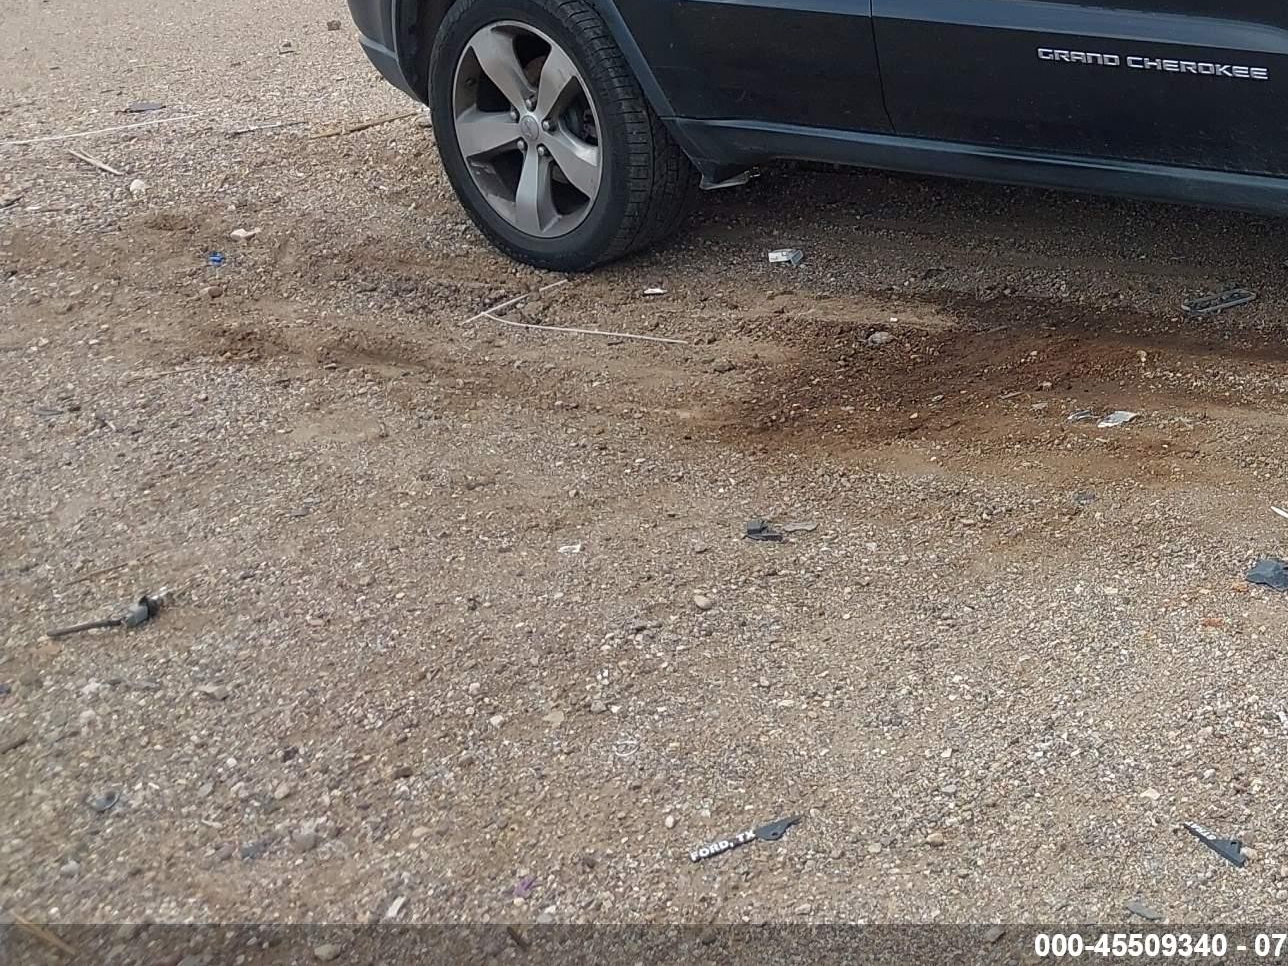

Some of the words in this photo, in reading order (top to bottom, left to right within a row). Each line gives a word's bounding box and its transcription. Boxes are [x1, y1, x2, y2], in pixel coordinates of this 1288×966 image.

[1037, 47, 1120, 66] GRAND
[1126, 56, 1268, 80] CHEROKEE
[690, 840, 734, 862] FORD,
[736, 830, 756, 842] TX
